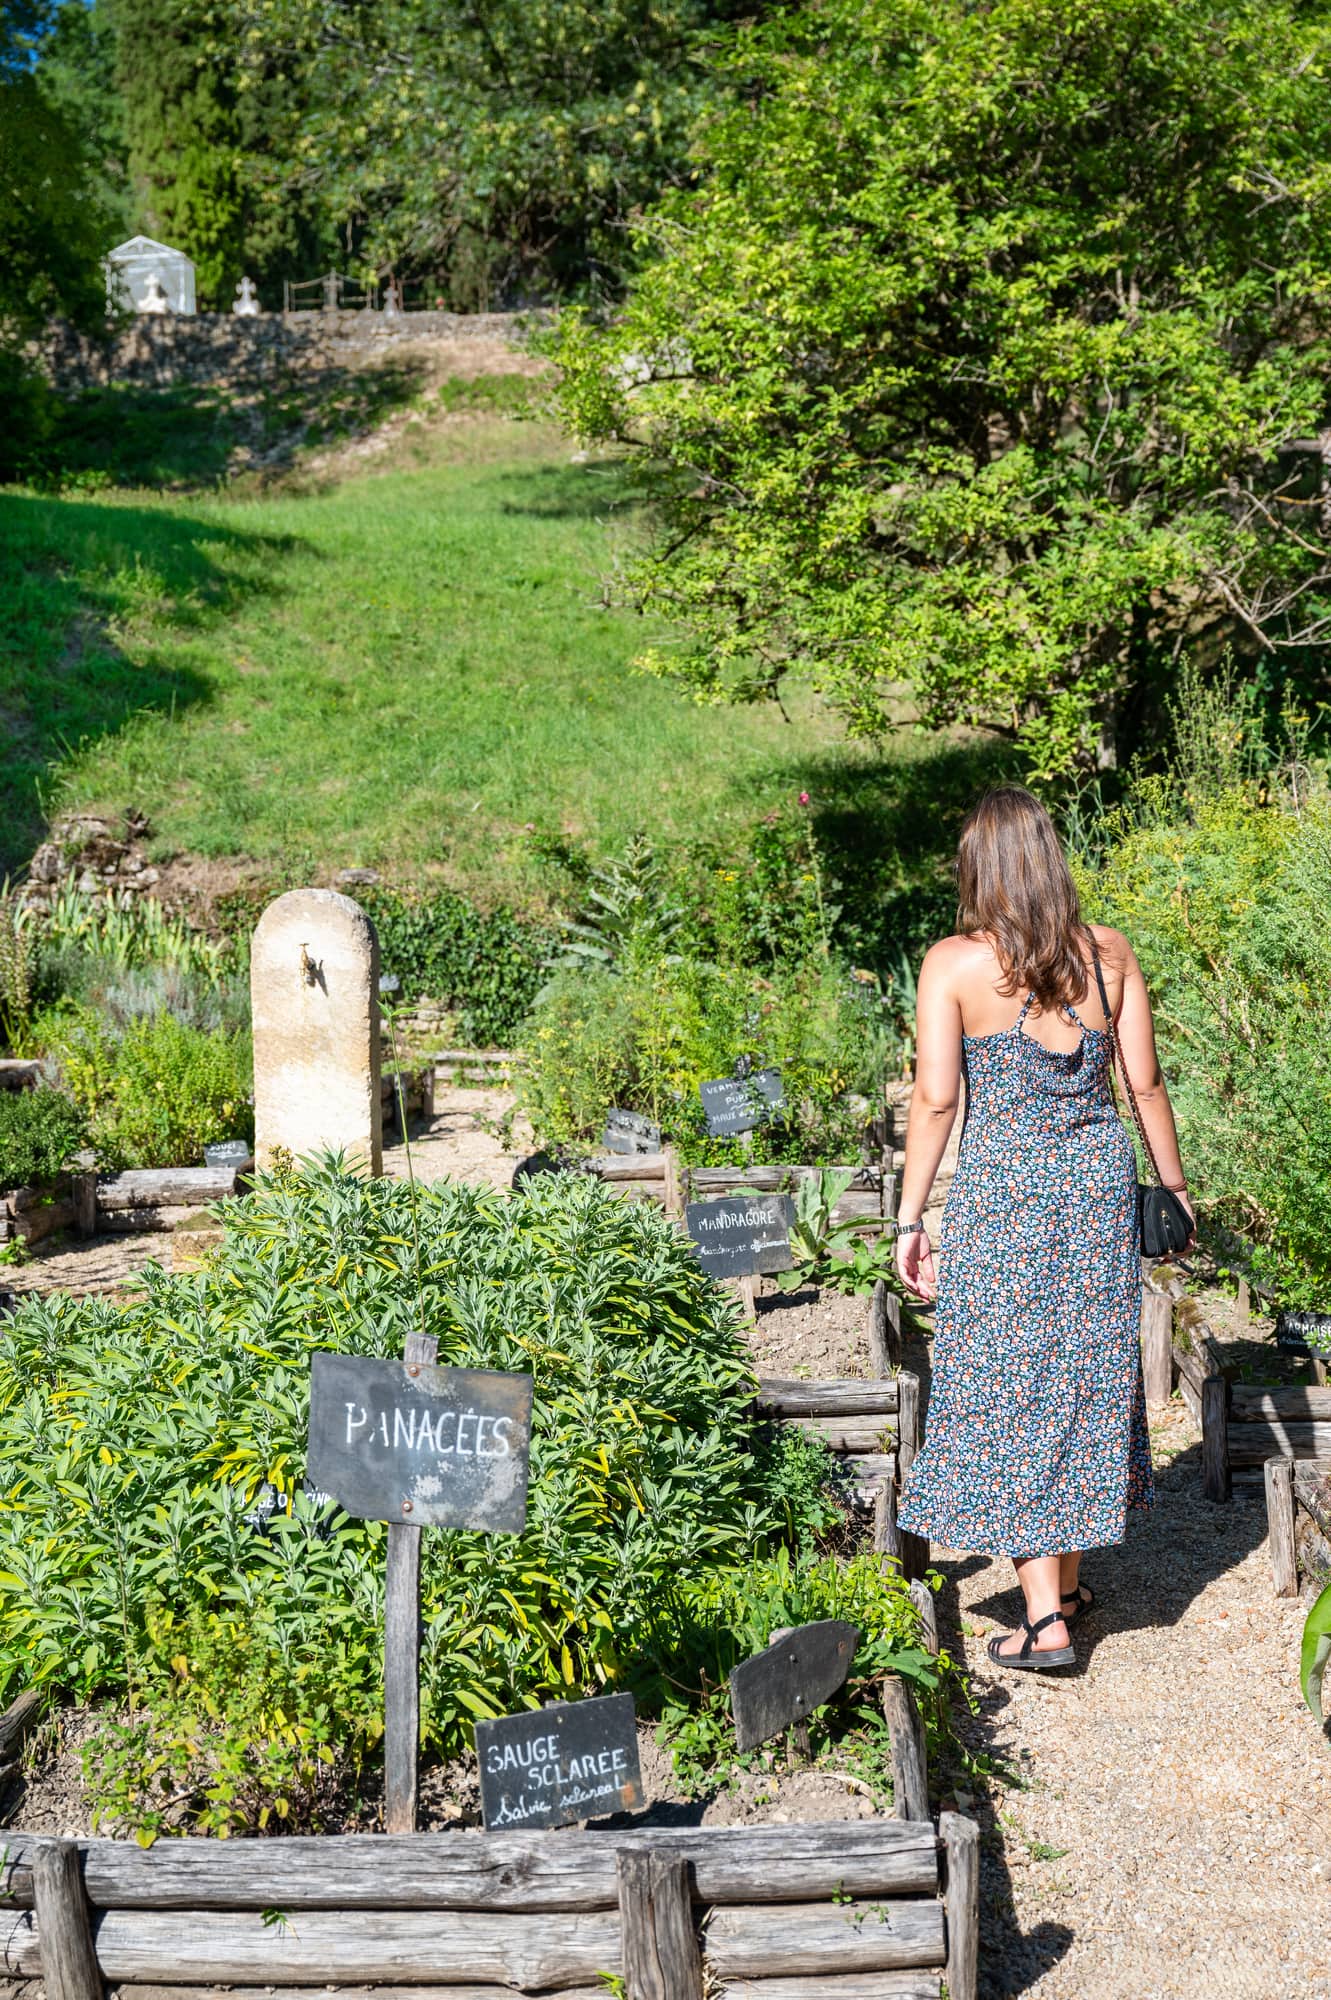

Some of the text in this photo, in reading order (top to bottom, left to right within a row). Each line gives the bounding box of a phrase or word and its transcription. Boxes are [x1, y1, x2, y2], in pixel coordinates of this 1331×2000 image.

[698, 1208, 777, 1232] MANDRAGORE
[345, 1402, 513, 1457] PANACÉES
[487, 1734, 561, 1774] SAUGE
[527, 1746, 628, 1790] SCLARÉE
